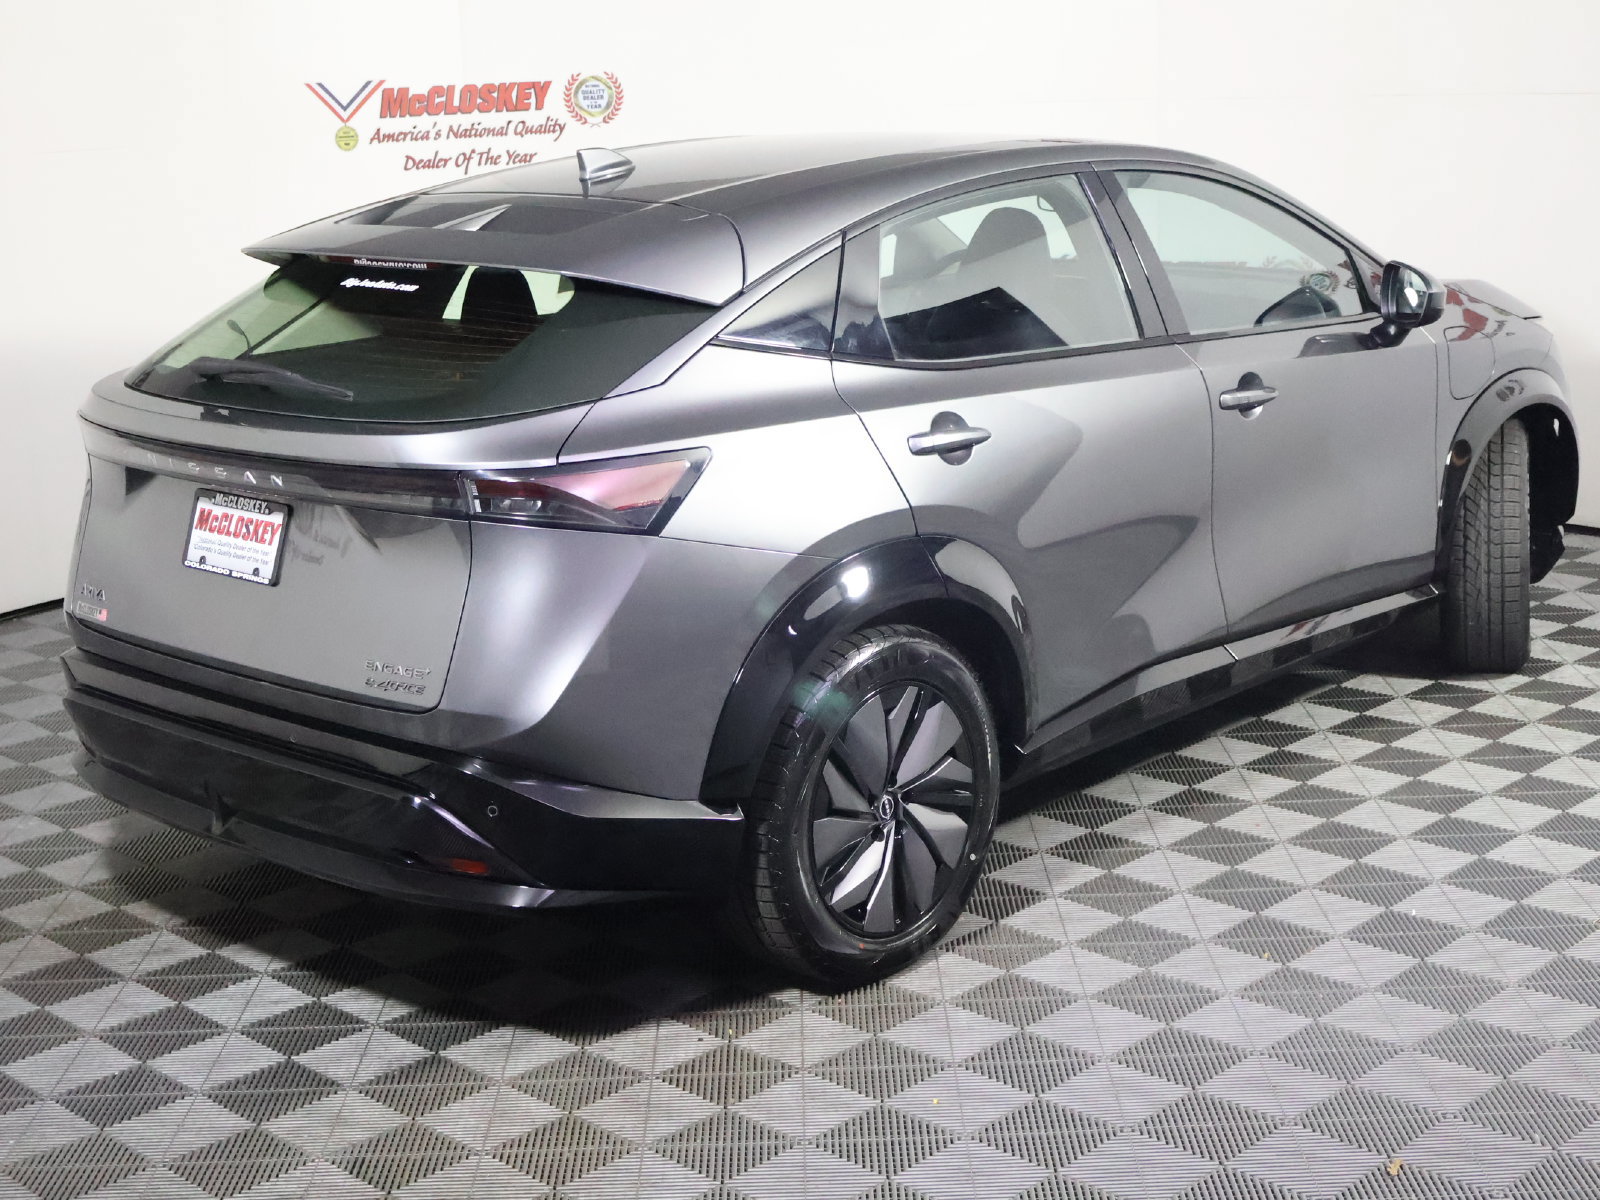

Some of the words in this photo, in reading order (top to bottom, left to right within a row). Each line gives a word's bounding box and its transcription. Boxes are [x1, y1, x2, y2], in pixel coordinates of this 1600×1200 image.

[380, 81, 552, 118] McCLOSKEY
[369, 121, 442, 144] America's
[446, 121, 512, 139] National
[513, 116, 566, 142] Quality
[403, 150, 453, 171] Dealer
[455, 148, 476, 175] Of
[477, 147, 502, 166] The
[506, 149, 538, 165] Year
[147, 453, 284, 487] NISSAN
[215, 493, 269, 514] McCLOSKEY
[195, 507, 282, 546] McCLOSKEY
[184, 560, 230, 575] COLORADO
[231, 571, 270, 585] SPRINGS
